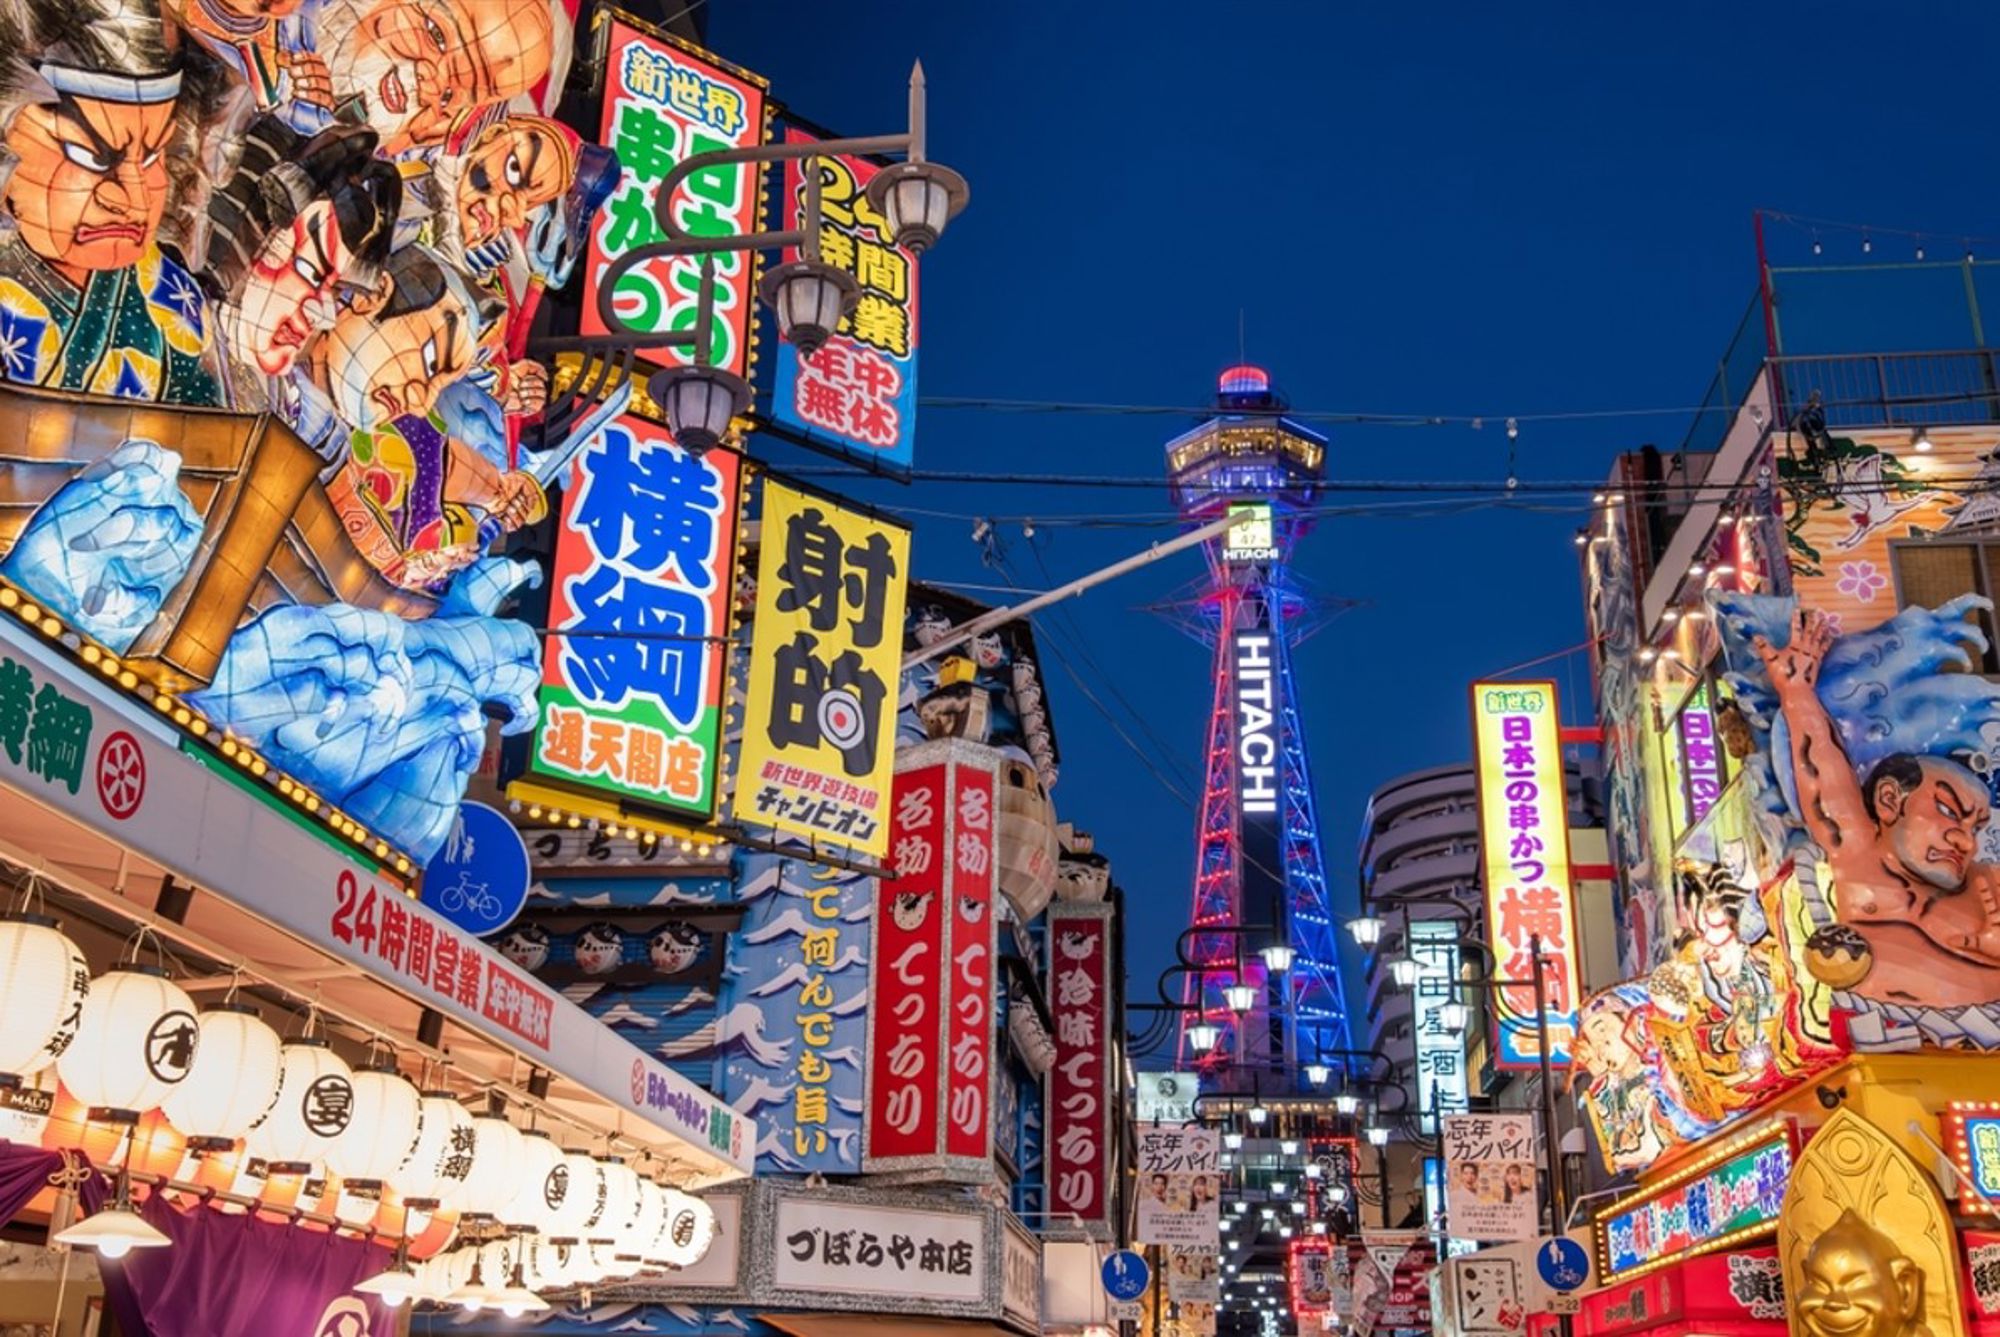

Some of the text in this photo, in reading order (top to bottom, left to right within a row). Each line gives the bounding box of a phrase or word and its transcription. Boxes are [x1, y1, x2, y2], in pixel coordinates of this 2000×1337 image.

[627, 47, 741, 134] 新世界
[604, 104, 677, 334] 串かつ
[671, 133, 738, 366] 日本一の
[803, 379, 895, 444] 無休
[808, 345, 896, 398] 年中
[564, 427, 718, 728] 横綱
[1222, 549, 1279, 560] HITACHI
[767, 507, 896, 777] 射的
[543, 710, 702, 797] 通天閣店
[1238, 636, 1276, 813] HITACHI
[756, 785, 878, 841] チャンピオン
[760, 759, 879, 811] 新世界遊技場
[1503, 715, 1545, 882] 日本一の串かつ
[332, 869, 482, 1011] 24時間営業
[885, 787, 933, 1135] 名物 てっちり
[951, 787, 990, 1136] 名物 てっちり
[1501, 886, 1567, 1017] 横綱
[490, 969, 548, 1042] 年中無休
[1057, 969, 1098, 1211] 珍味てっちり
[1446, 1119, 1493, 1141] 忘年
[1140, 1133, 1184, 1154] 忘年
[1144, 1151, 1218, 1172] カンパイ!
[1452, 1137, 1532, 1161] カンパイ!
[787, 1226, 974, 1276] づぼらや本店
[1731, 1256, 1783, 1269] 日本一の
